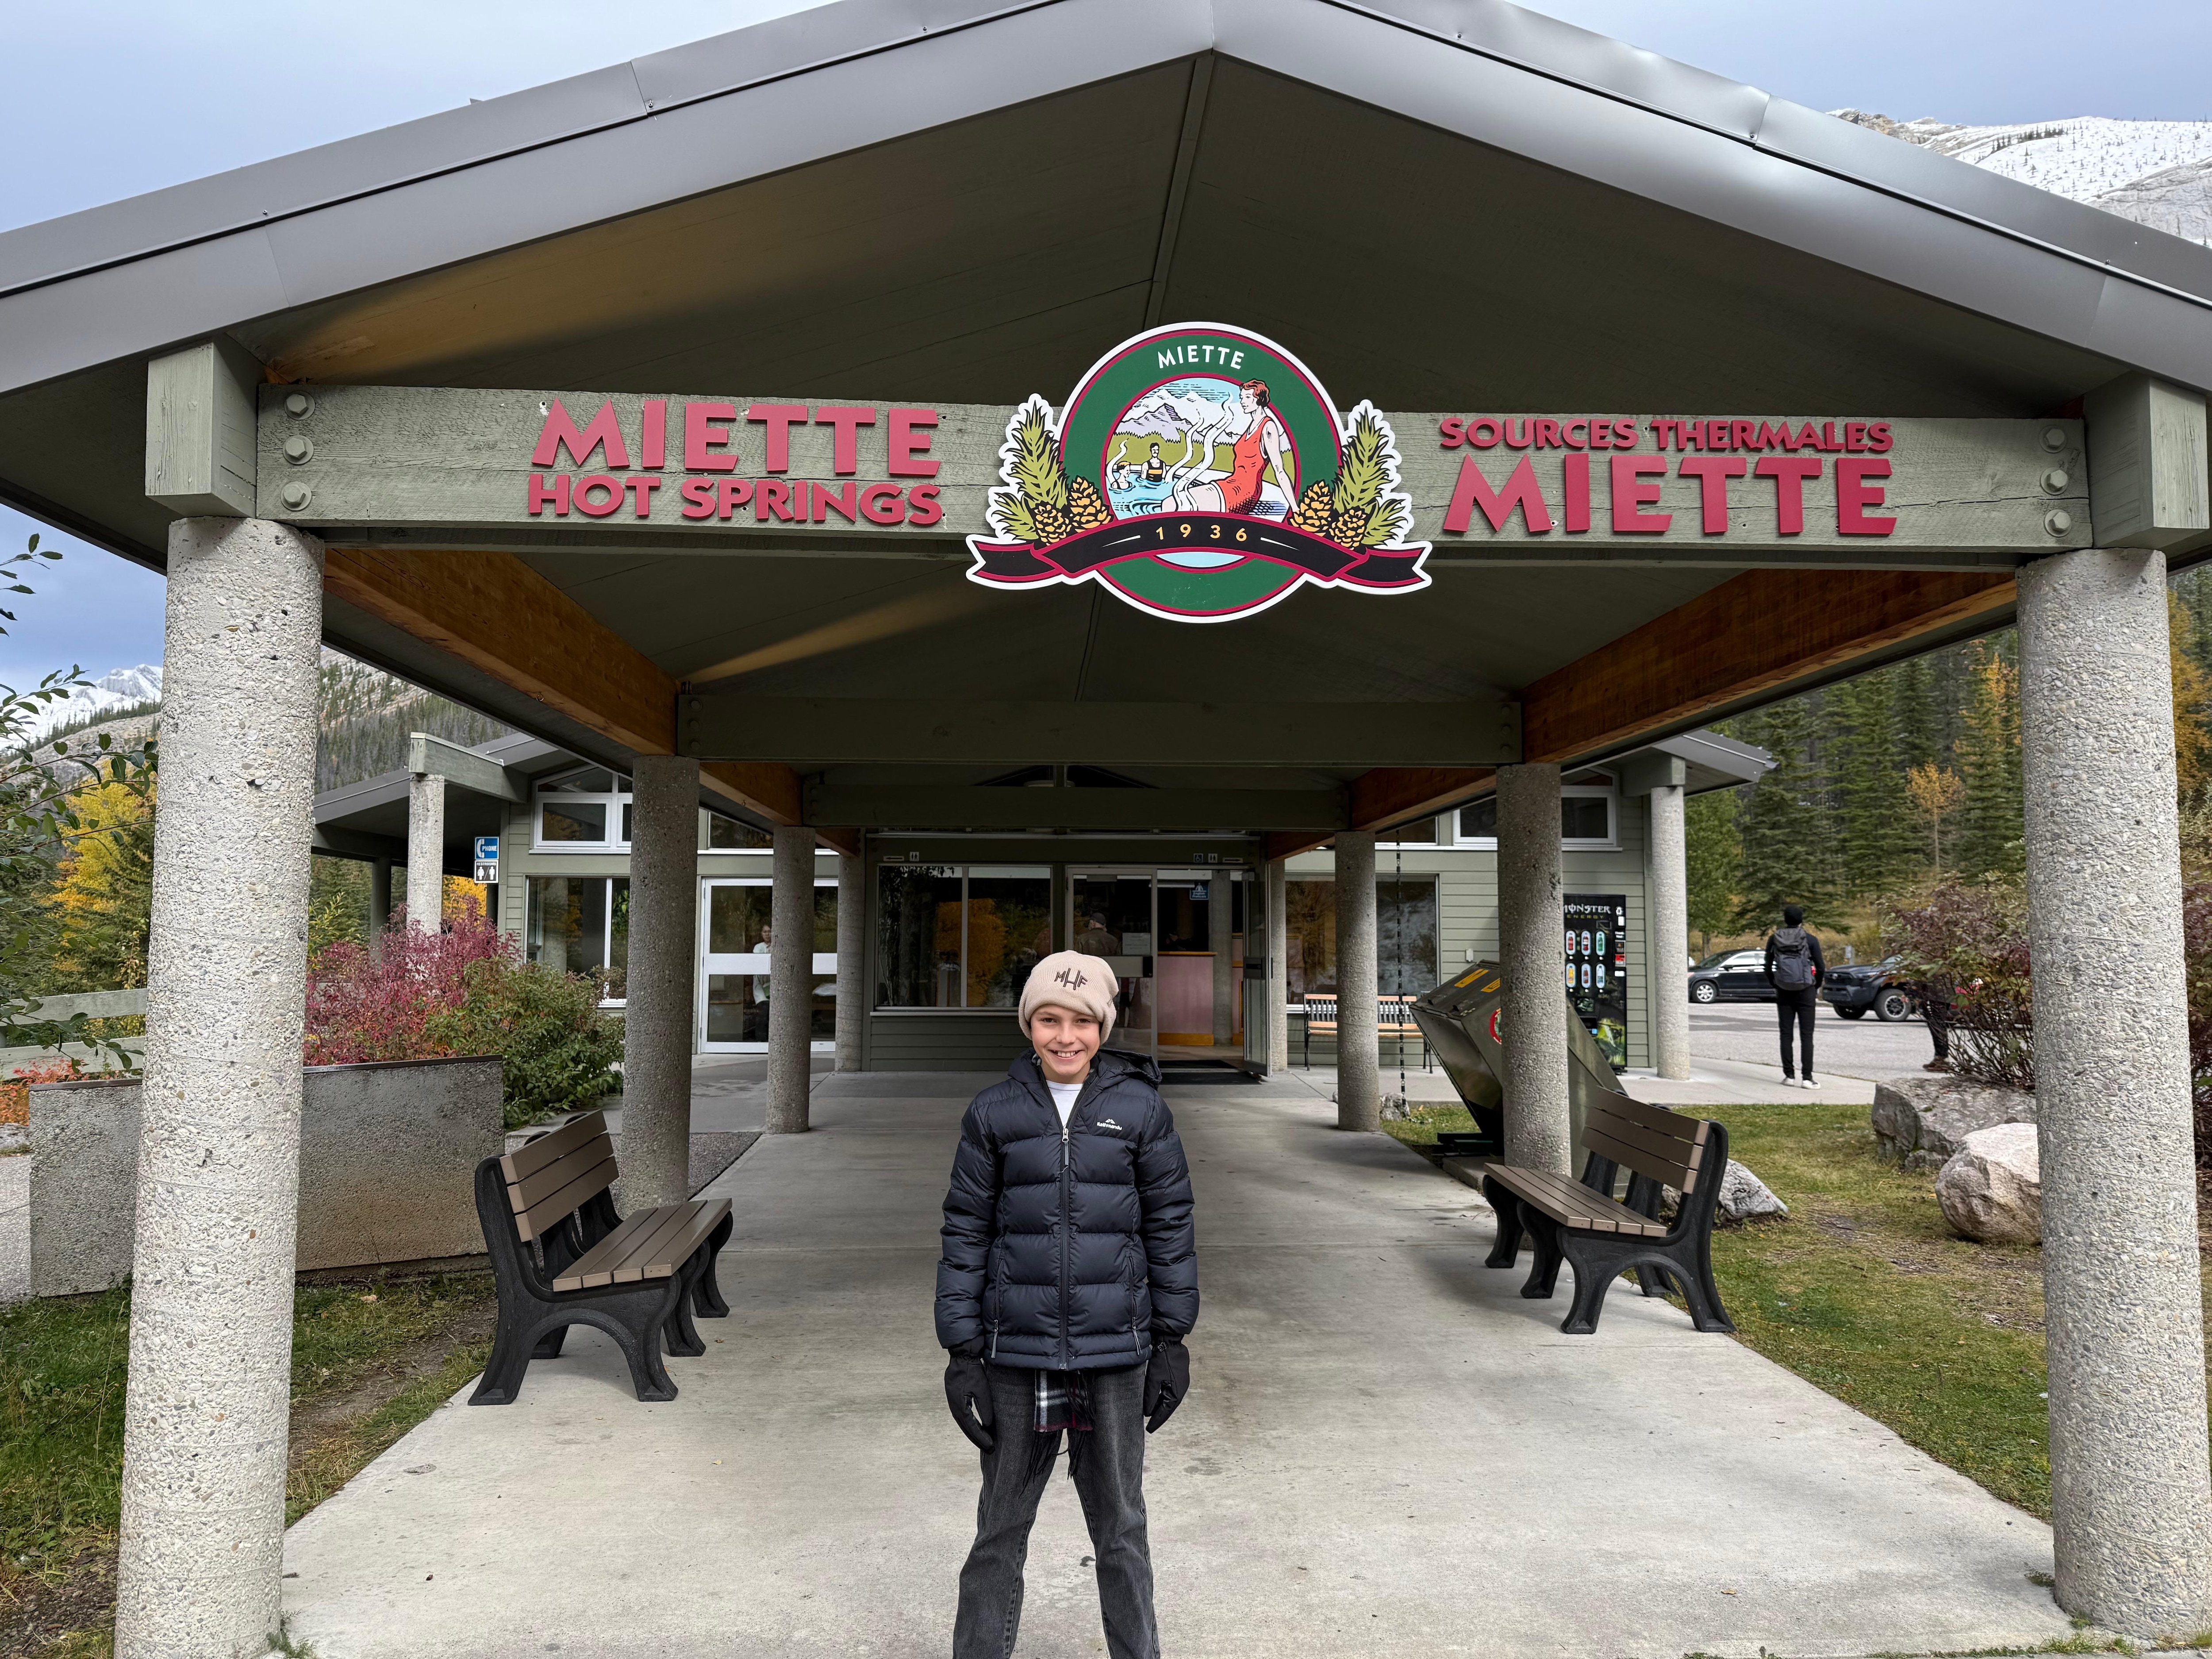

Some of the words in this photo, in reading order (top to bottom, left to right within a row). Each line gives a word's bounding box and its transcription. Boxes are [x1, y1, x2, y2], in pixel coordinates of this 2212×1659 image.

[1157, 345, 1244, 369] MIETTE
[531, 397, 941, 477] MIETTE
[1440, 417, 1638, 448] SOURCES
[1650, 420, 1893, 451] THERMALES
[529, 473, 661, 517] HOT
[681, 477, 942, 525] SPRINGS
[1443, 453, 1897, 534] MIETTE
[1156, 523, 1247, 541] 1936
[1054, 968, 1087, 990] MHF
[1097, 1121, 1122, 1130] Kathmandu
